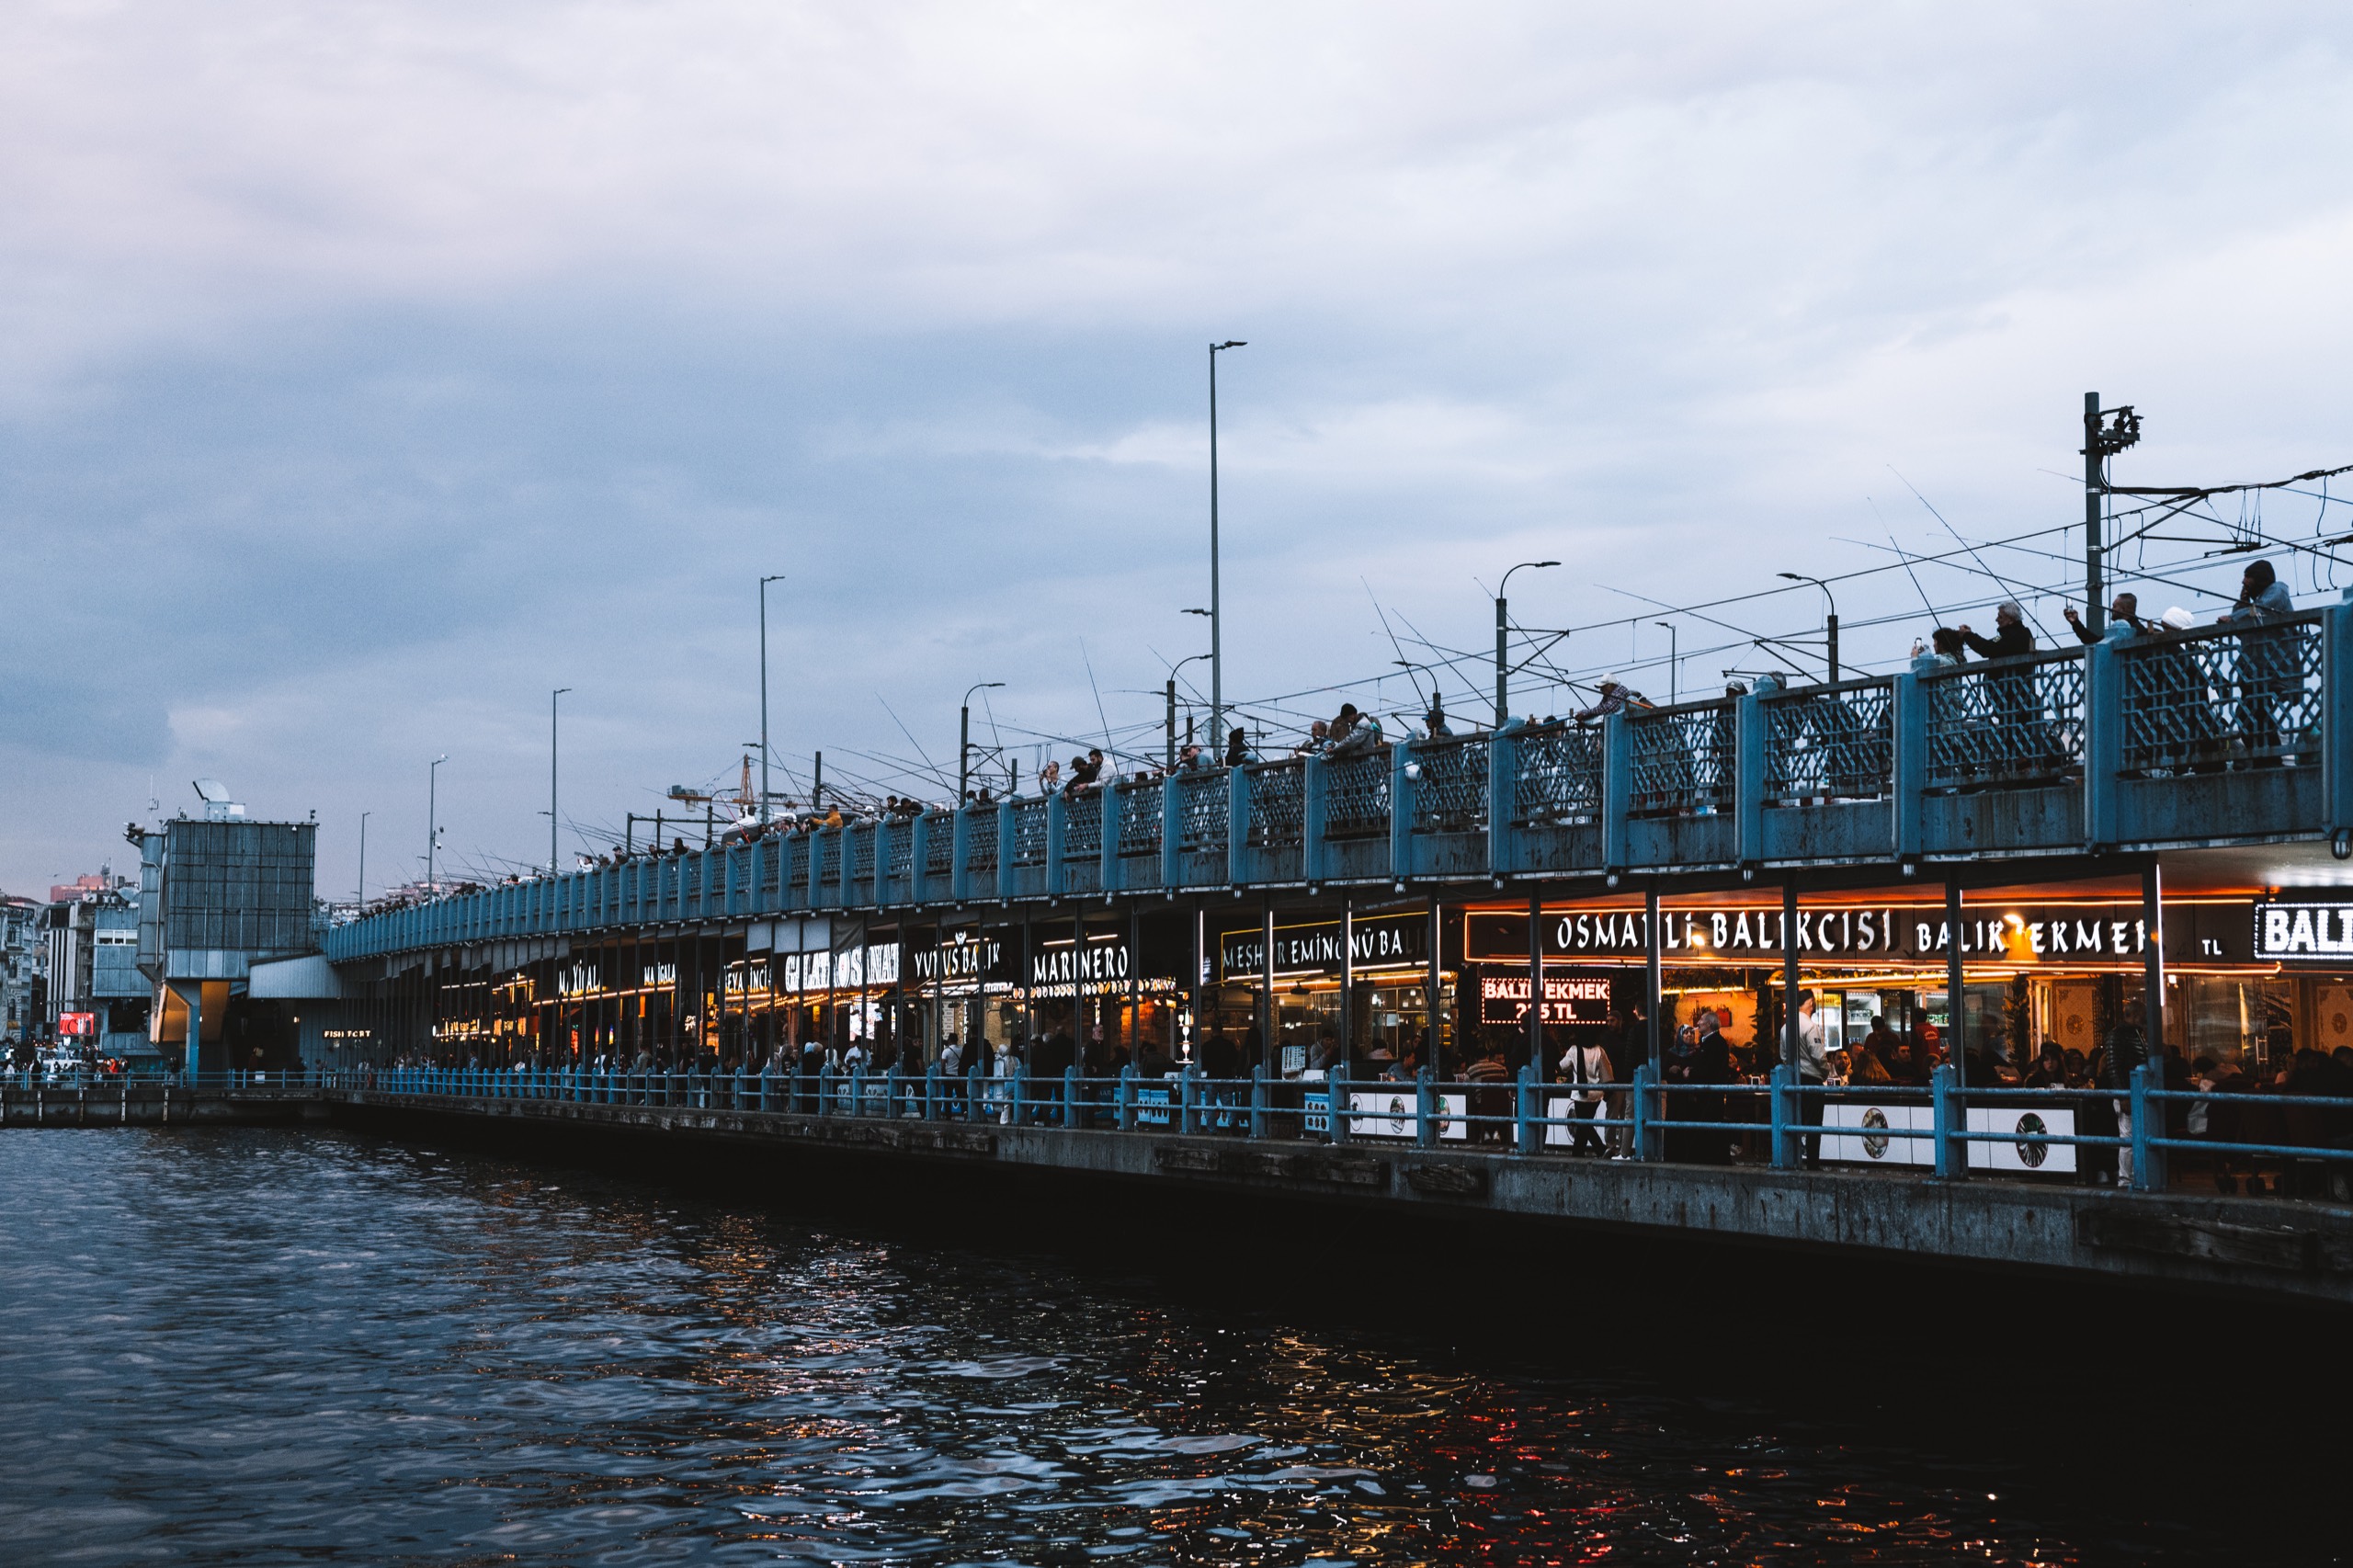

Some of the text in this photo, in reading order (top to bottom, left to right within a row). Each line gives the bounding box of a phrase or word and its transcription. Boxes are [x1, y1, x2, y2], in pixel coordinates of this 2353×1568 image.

[1557, 911, 1692, 949] OSMALI
[1916, 920, 2005, 953] BALIK
[962, 942, 1000, 973] BAIK
[1222, 941, 1286, 970] MEŞHR
[2202, 939, 2222, 955] TL
[1034, 946, 1129, 984] MARINERO
[1545, 982, 1608, 1000] EKMEK
[1517, 1003, 1577, 1019] 25 TL
